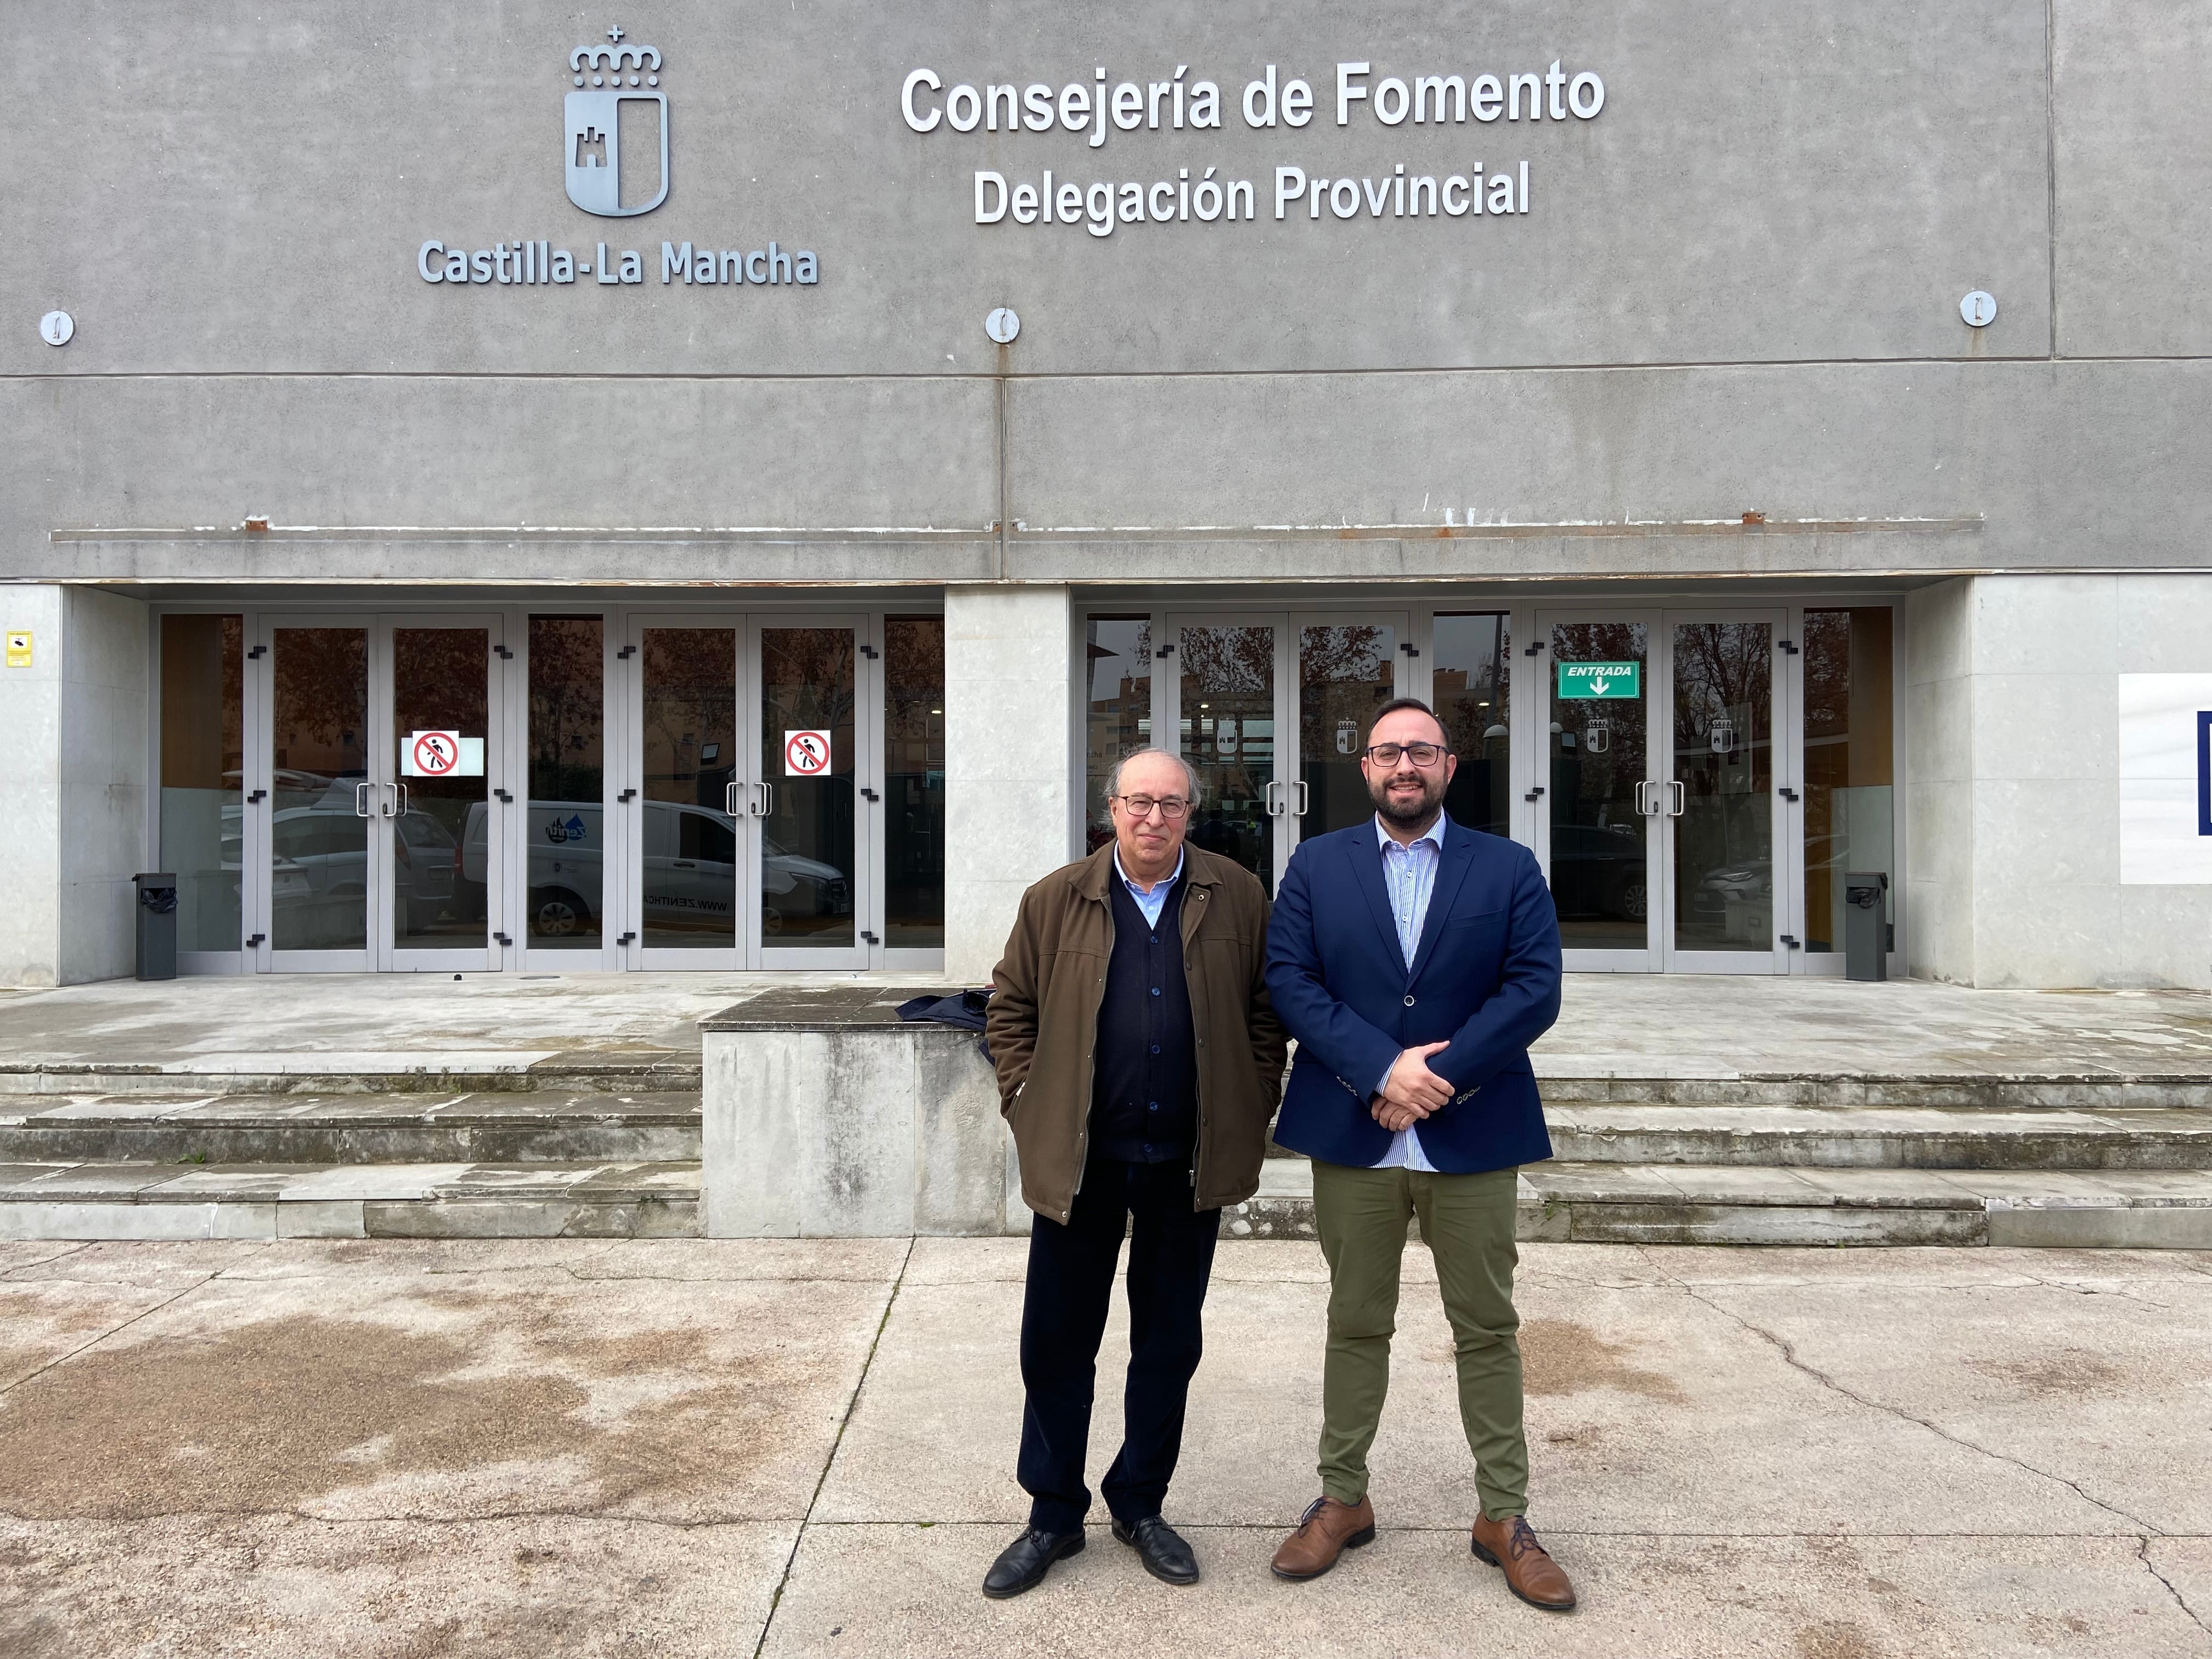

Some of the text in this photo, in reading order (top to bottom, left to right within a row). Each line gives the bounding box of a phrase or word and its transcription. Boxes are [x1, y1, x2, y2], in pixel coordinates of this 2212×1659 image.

[901, 59, 1605, 147] Consejería de Fomento
[974, 161, 1529, 236] Delegación Provincial
[418, 240, 818, 284] Castilla-La Mancha
[1567, 667, 1631, 676] ENTRADA
